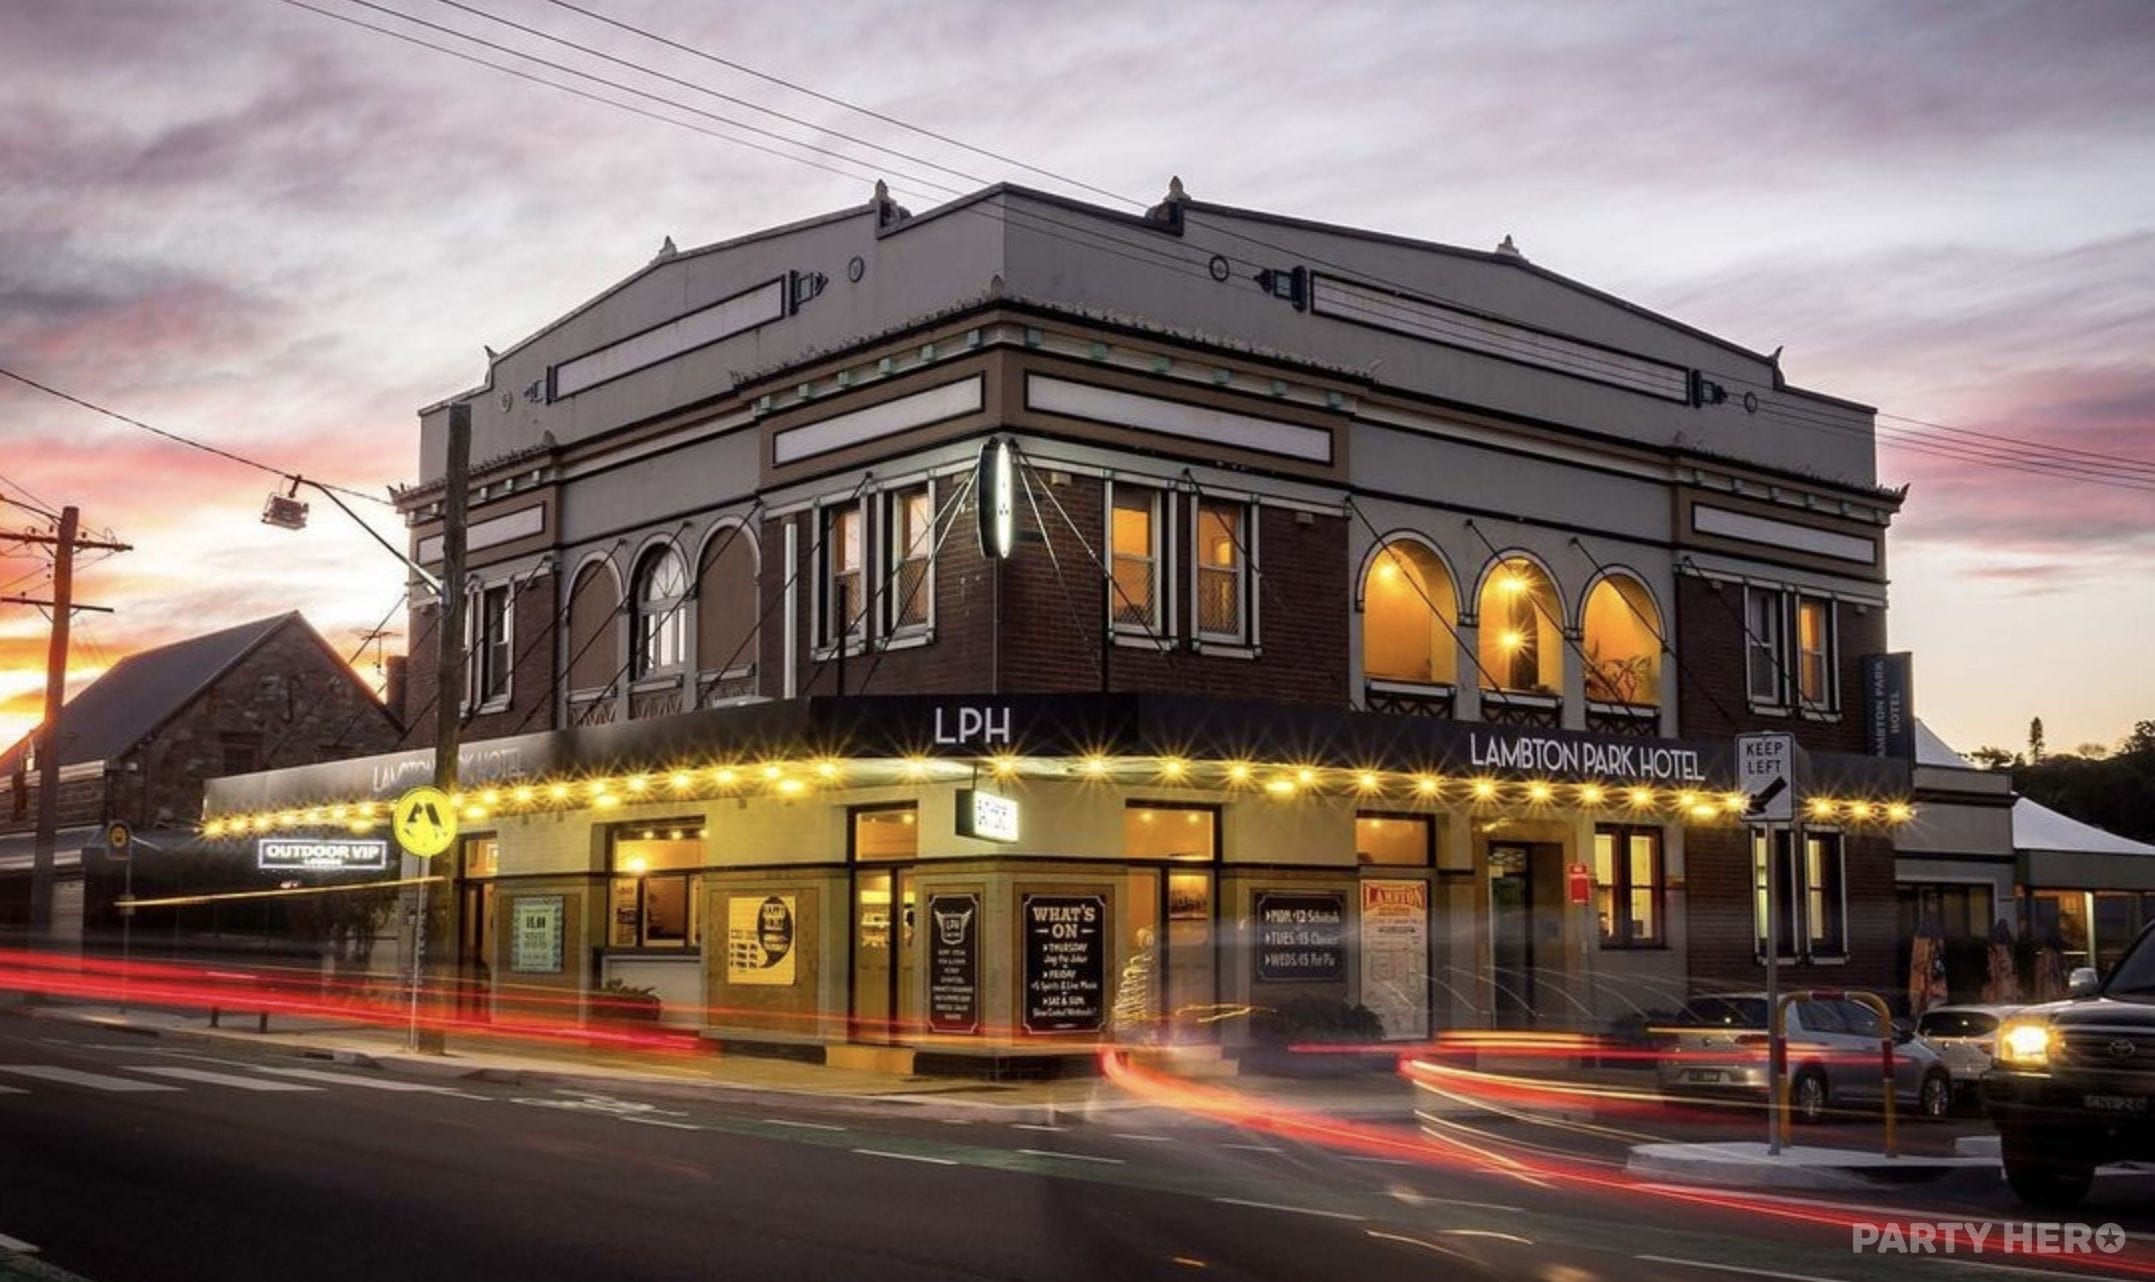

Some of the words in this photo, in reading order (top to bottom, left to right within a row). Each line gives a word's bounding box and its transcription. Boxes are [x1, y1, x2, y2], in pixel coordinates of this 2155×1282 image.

[936, 707, 1009, 743] LPH
[1876, 700, 1886, 758] AMBTON
[1746, 741, 1784, 756] KEEP
[1470, 733, 1579, 772] LAMBTON
[1584, 742, 1636, 777] PARK
[1640, 747, 1705, 781] HOTEL
[1748, 760, 1781, 774] LEFT
[266, 844, 349, 859] OUTDOOR
[352, 845, 380, 859] VIP
[1033, 904, 1096, 922] WHAT'S
[1052, 924, 1078, 939] ON
